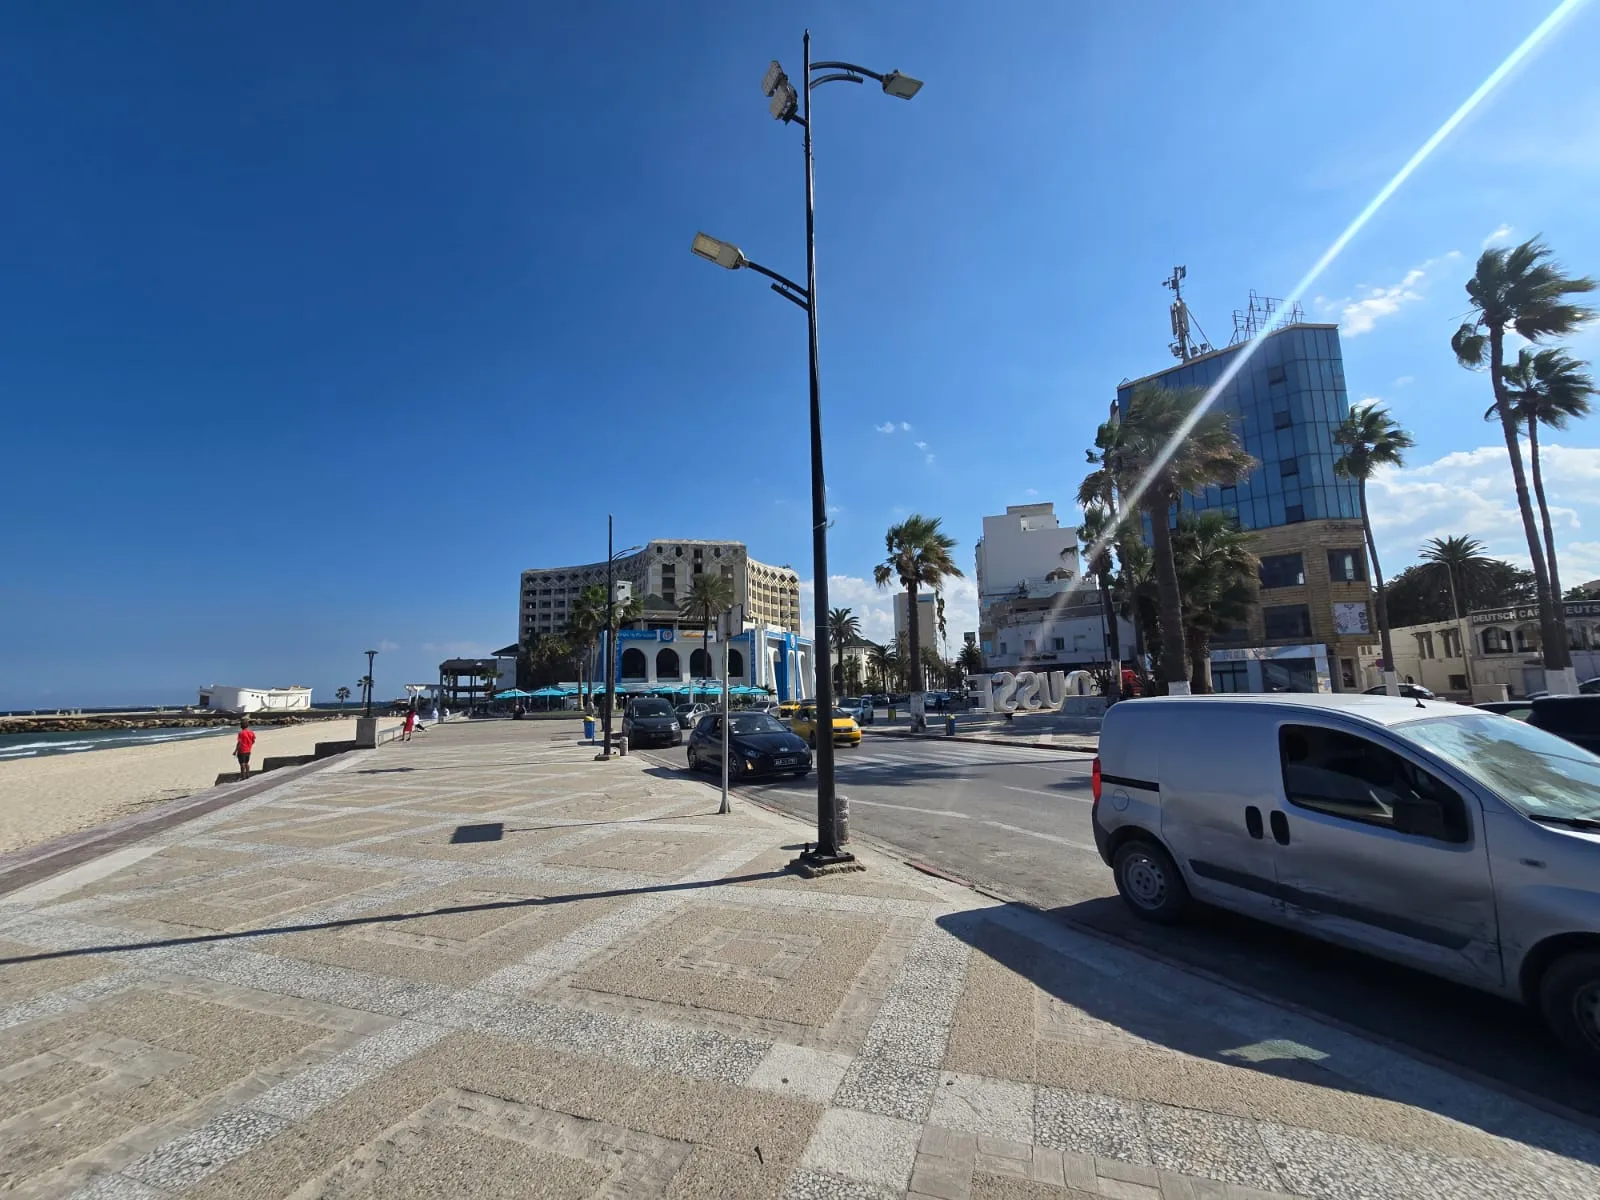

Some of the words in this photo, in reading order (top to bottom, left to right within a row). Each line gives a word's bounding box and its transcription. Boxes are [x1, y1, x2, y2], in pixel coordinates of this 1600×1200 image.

[1472, 610, 1516, 623] DEUTSCH
[1519, 608, 1540, 618] CAF
[1562, 604, 1600, 615] EUTS
